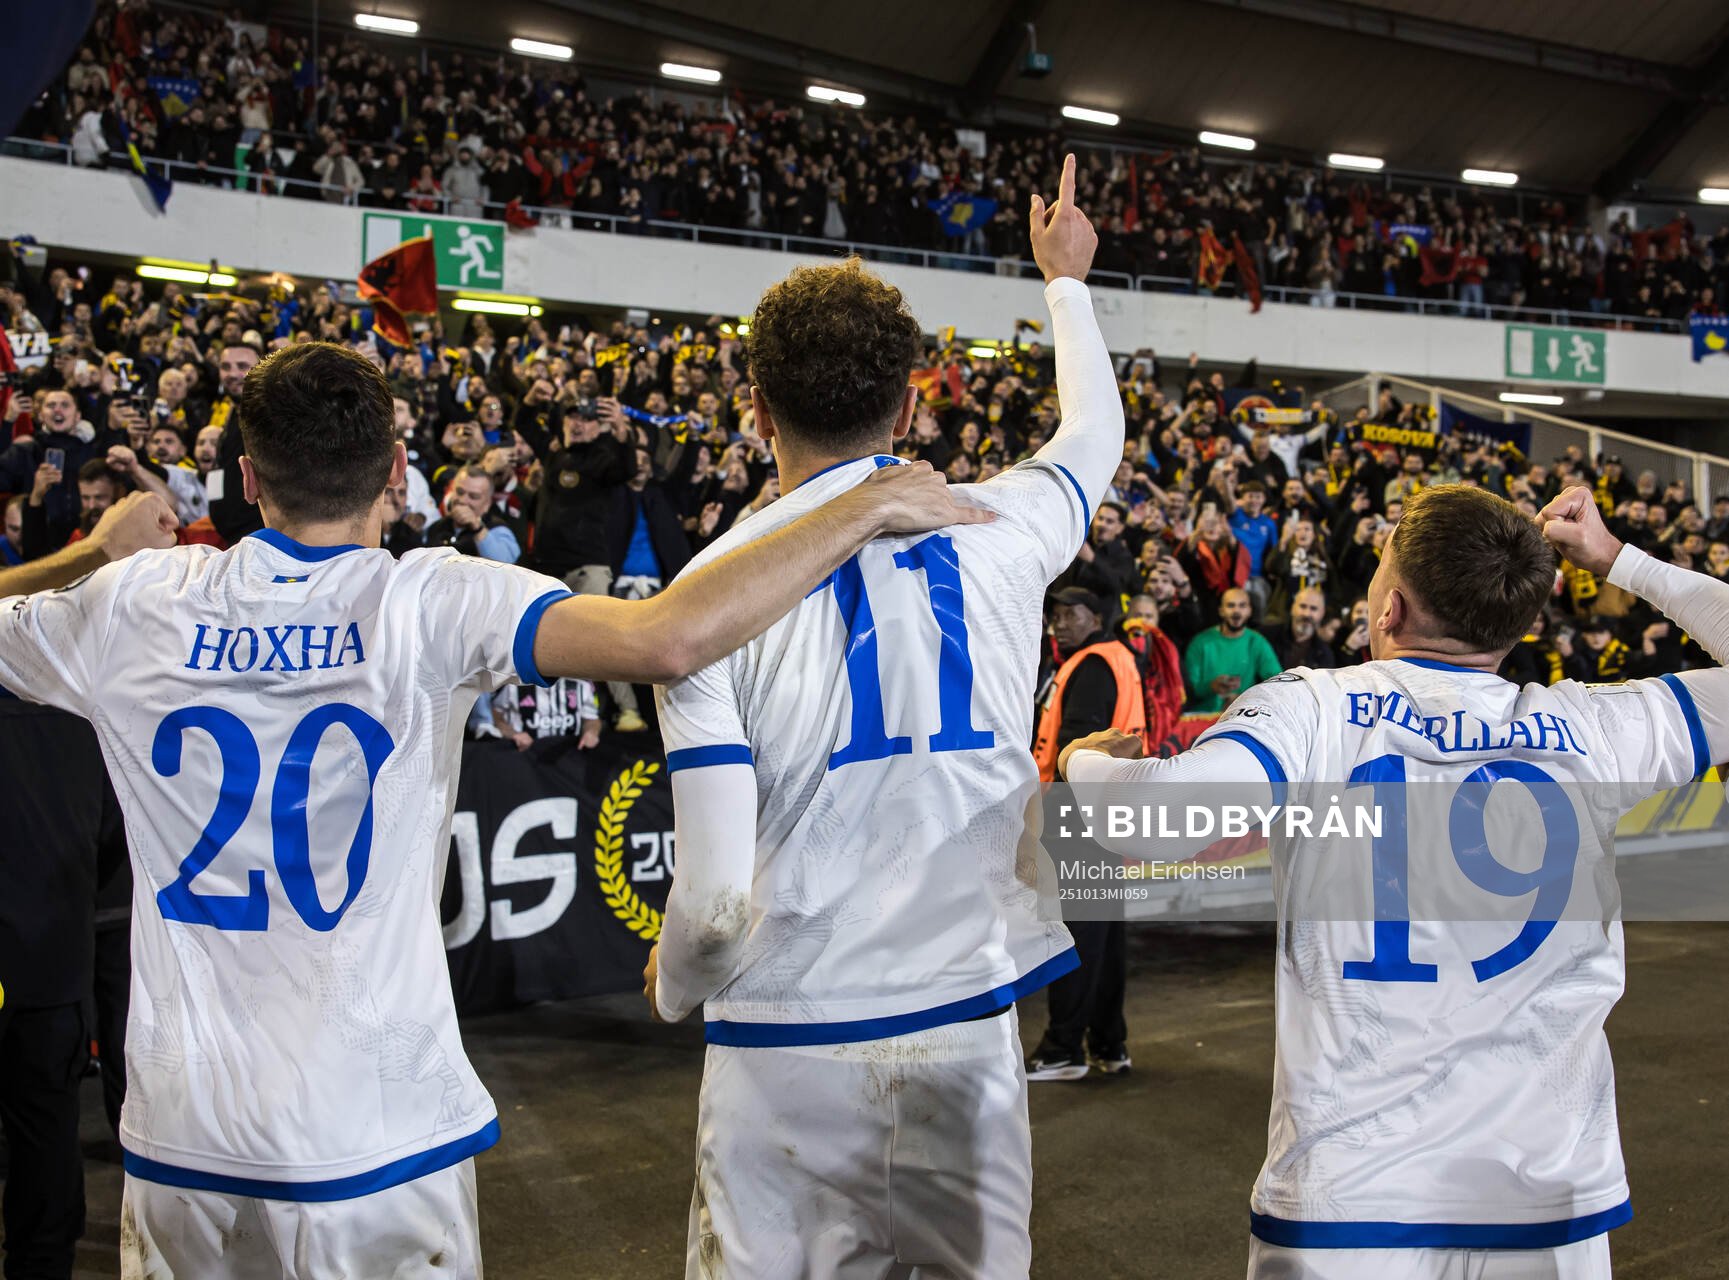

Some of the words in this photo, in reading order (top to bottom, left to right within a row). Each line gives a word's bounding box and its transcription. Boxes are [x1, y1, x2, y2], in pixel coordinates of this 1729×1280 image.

[1362, 423, 1435, 448] KOSOVA
[184, 621, 366, 673] HOXHA
[804, 533, 995, 772] 11
[526, 711, 575, 736] Jeep
[151, 702, 395, 932] 20
[1342, 753, 1580, 983] 19
